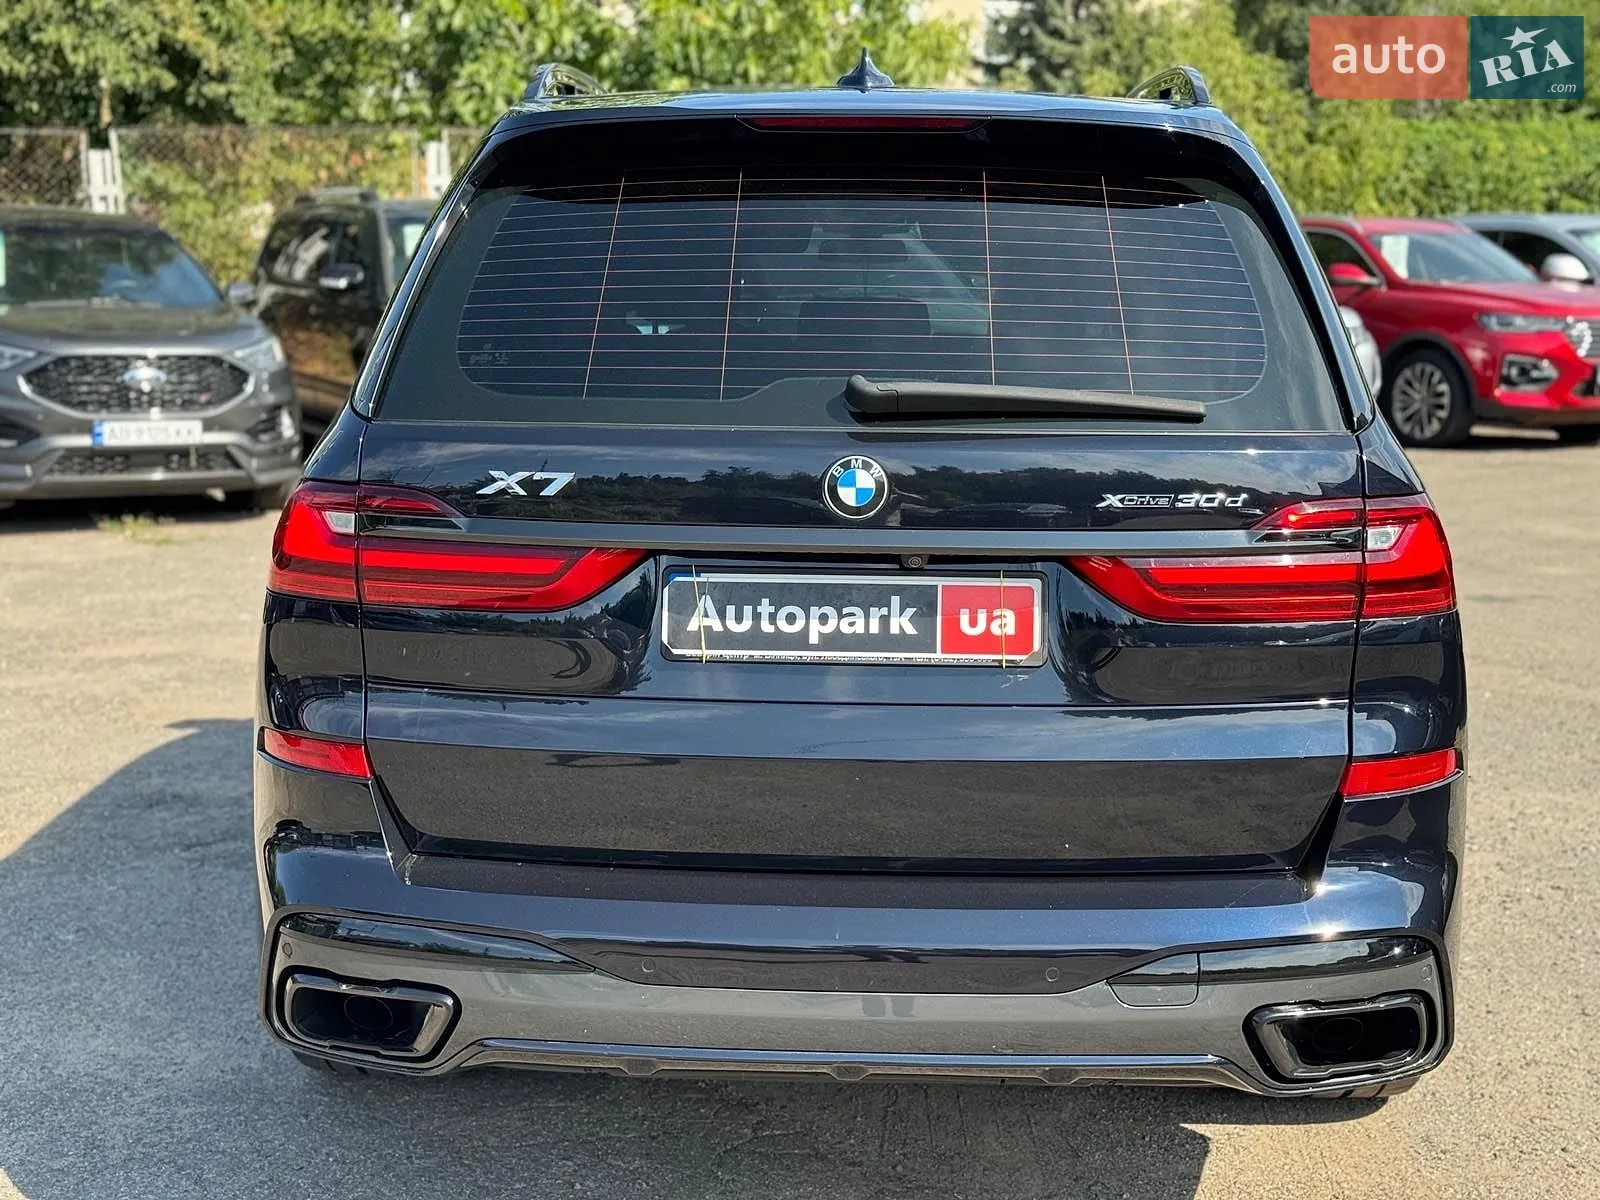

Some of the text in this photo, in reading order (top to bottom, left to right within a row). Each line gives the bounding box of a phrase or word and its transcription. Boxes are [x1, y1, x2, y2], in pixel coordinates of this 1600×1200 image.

[832, 458, 882, 478] BMW
[475, 470, 576, 496] X7
[686, 594, 1016, 645] Autopark ua
